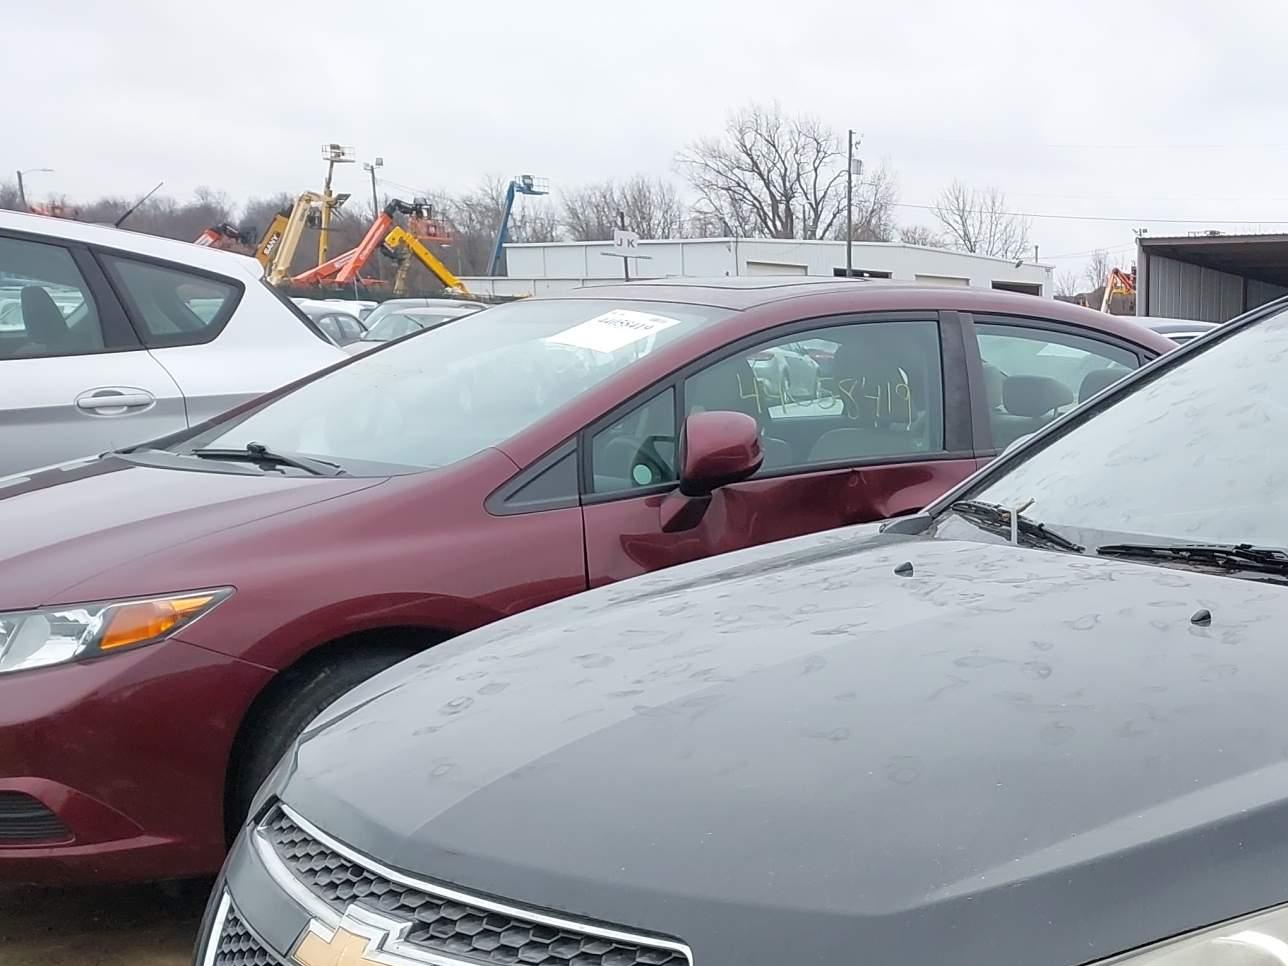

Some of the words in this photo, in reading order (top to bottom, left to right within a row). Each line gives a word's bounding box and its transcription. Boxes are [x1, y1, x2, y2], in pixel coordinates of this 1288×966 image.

[263, 233, 281, 256] SANY
[616, 238, 623, 247] J
[627, 238, 636, 248] K
